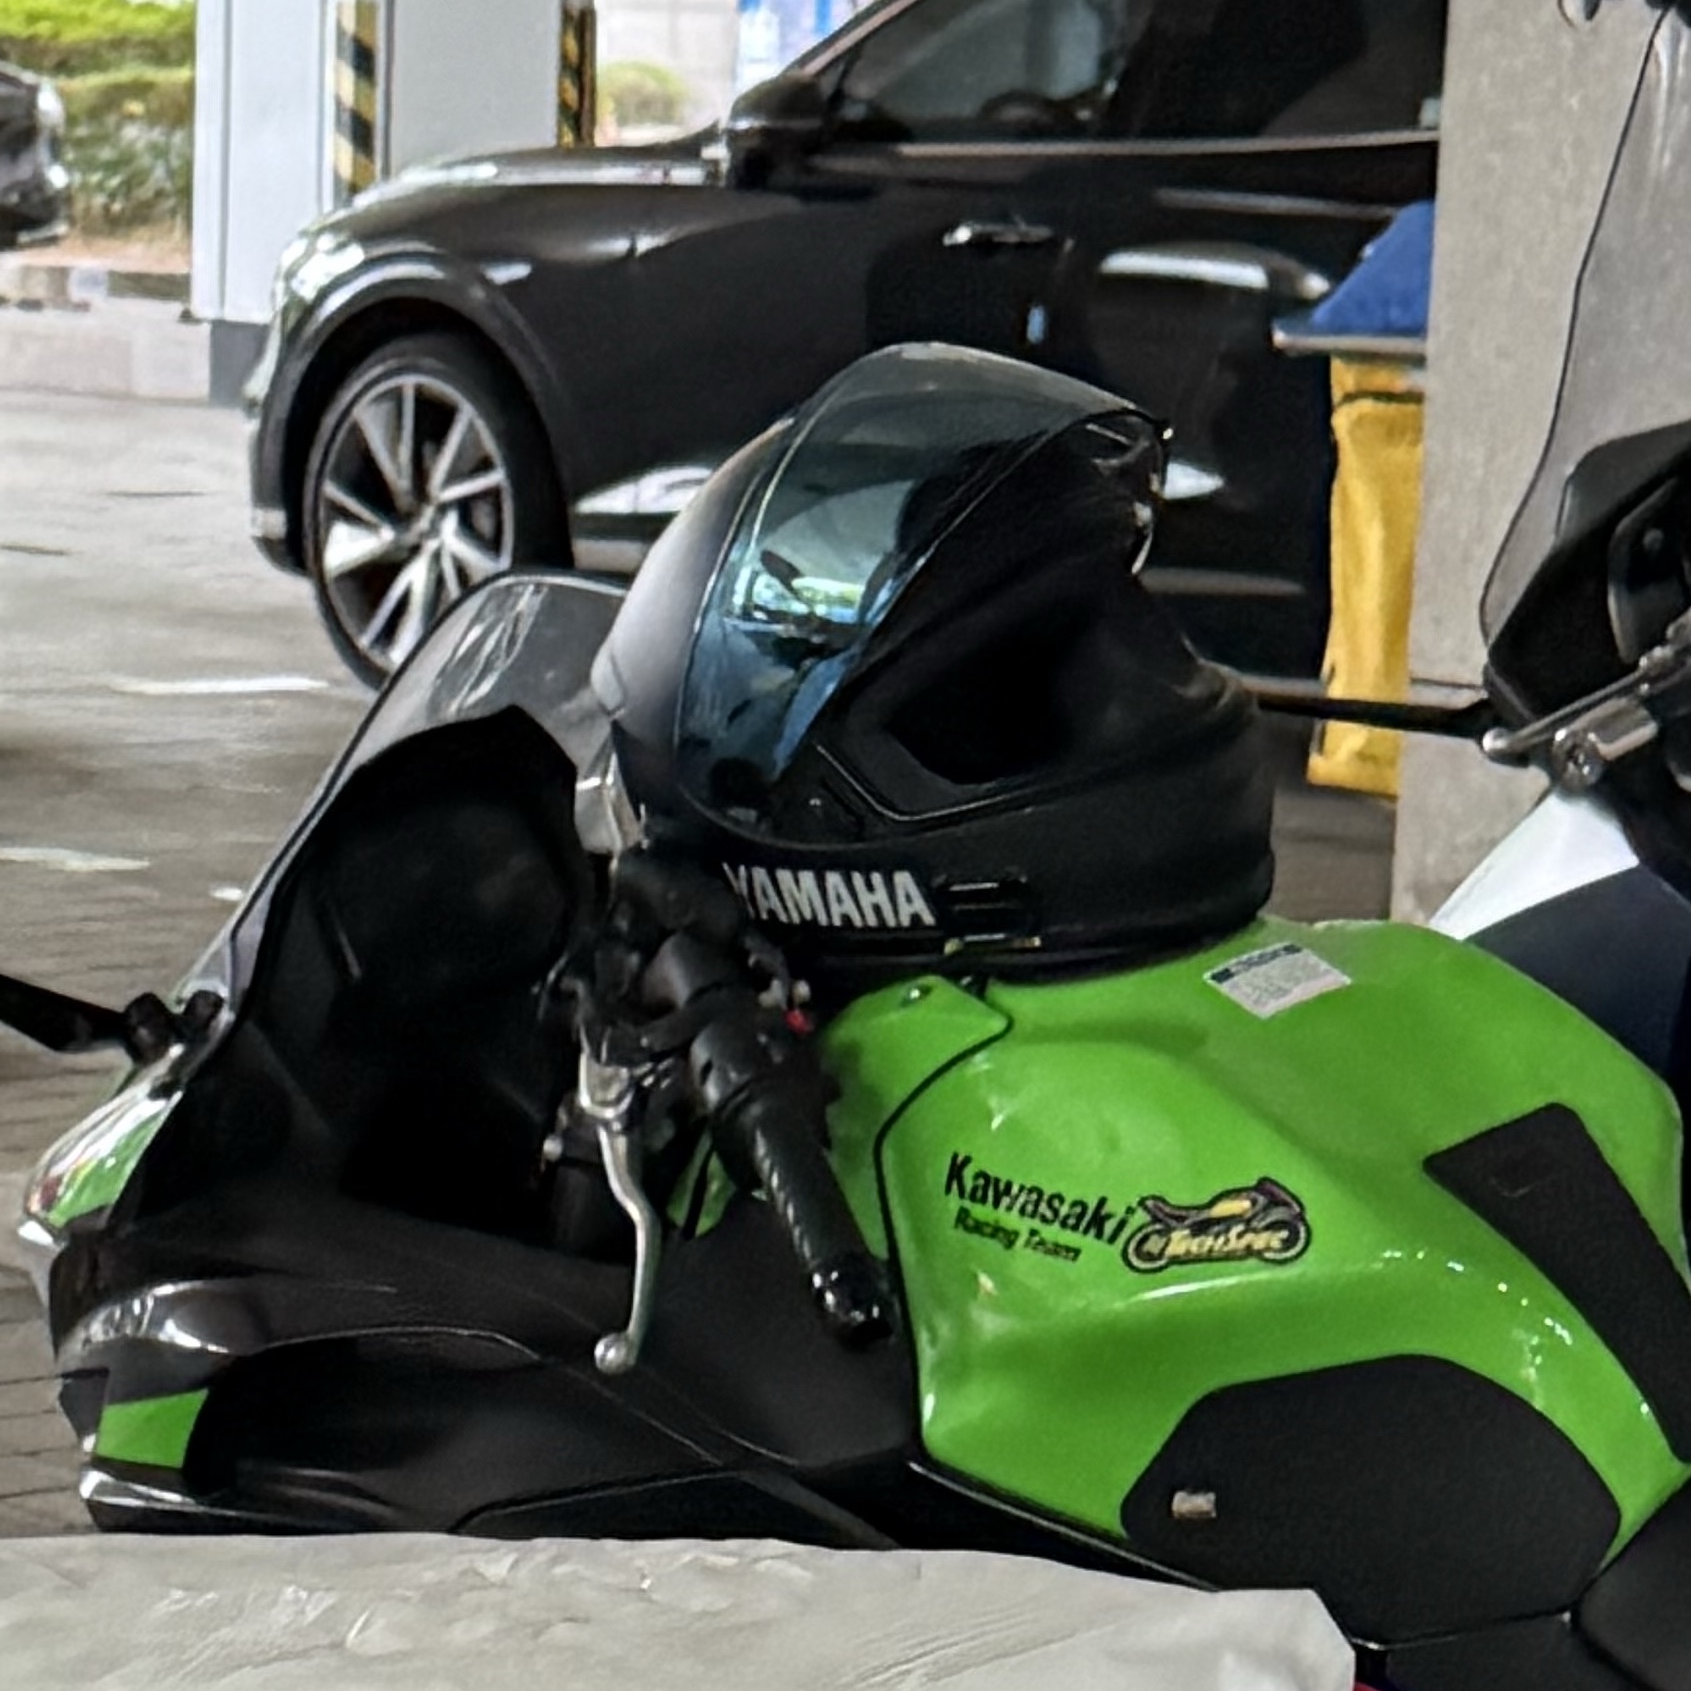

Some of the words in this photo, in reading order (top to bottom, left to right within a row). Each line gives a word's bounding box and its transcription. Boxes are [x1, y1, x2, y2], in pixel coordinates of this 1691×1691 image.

[721, 861, 936, 928] YAMAHA
[944, 1150, 1136, 1245] Kawasaki
[954, 1205, 1021, 1251] Racing
